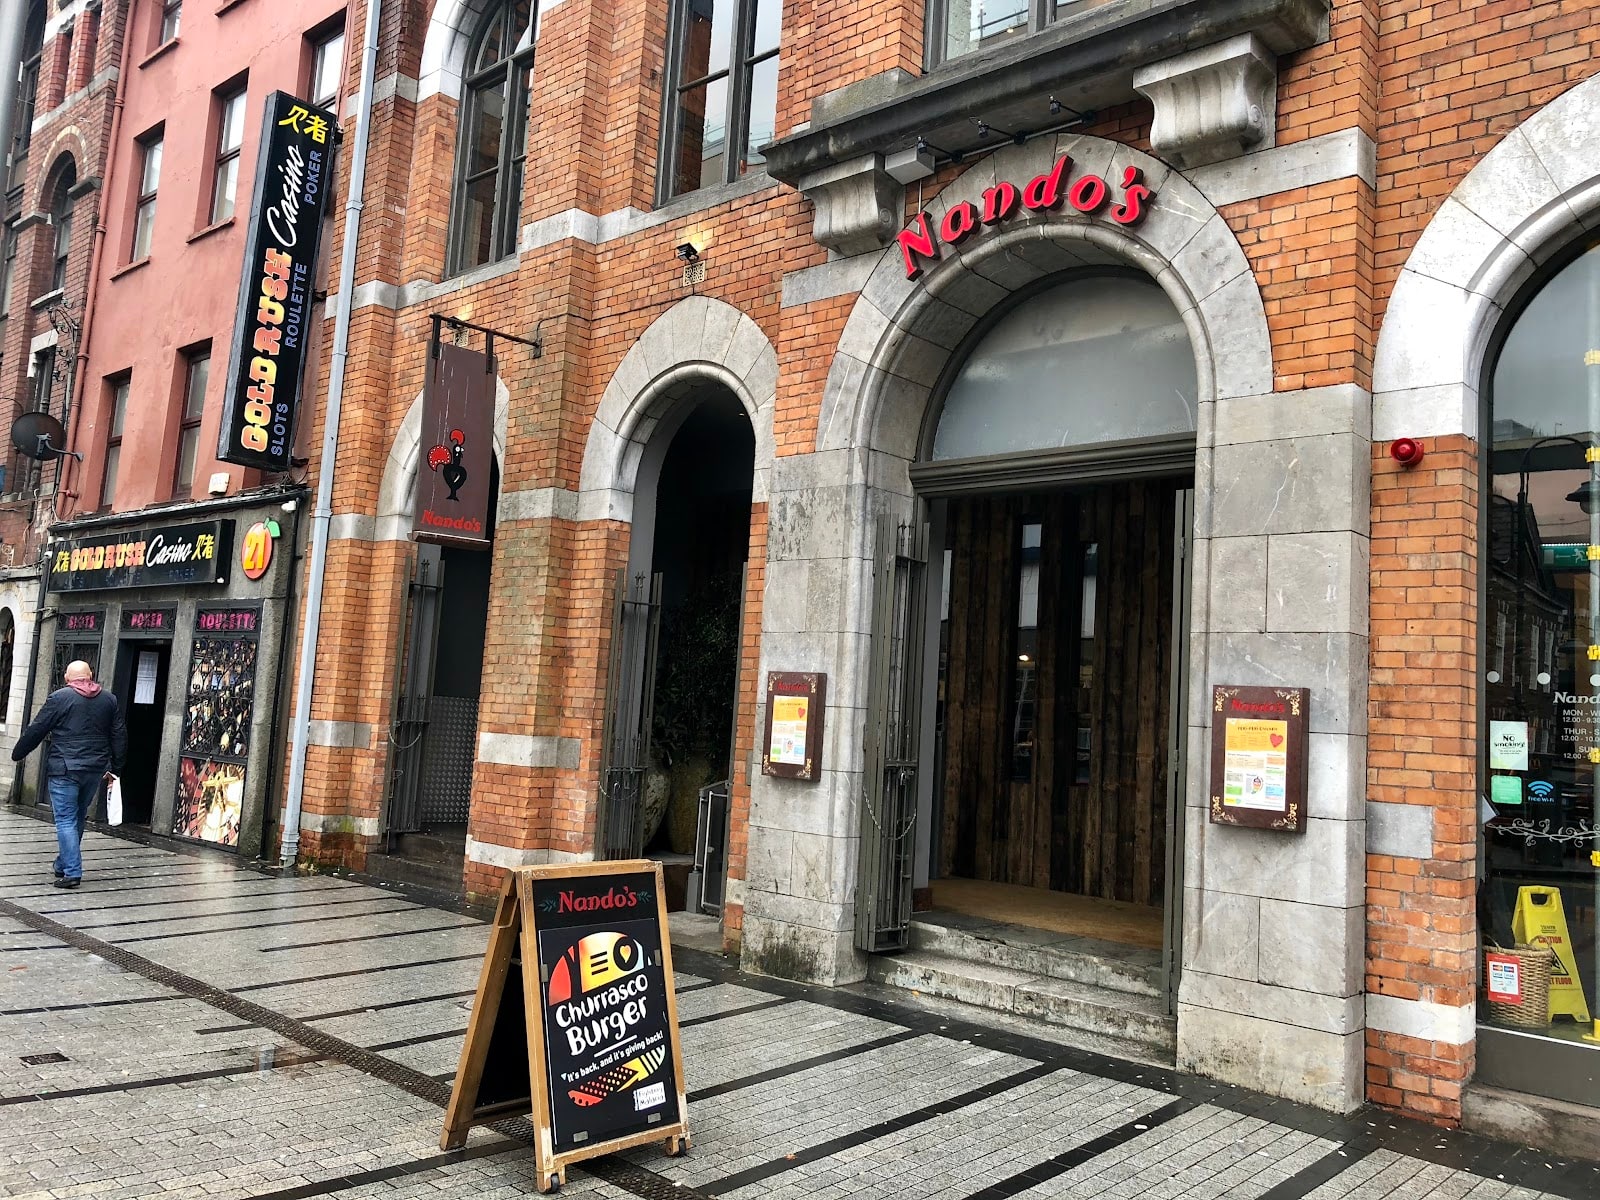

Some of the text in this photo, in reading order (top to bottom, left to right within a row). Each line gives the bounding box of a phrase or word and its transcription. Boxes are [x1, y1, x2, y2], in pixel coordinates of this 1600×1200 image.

[304, 149, 322, 205] POKER
[896, 153, 1156, 282] Nando's
[240, 145, 304, 452] GOLD RUSH Casino
[285, 263, 307, 347] ROULETTE
[271, 403, 289, 456] SLOTS
[420, 510, 481, 532] Nando's
[70, 546, 104, 572] GOLD
[104, 541, 146, 567] RUSH
[146, 534, 193, 568] Casino
[244, 533, 267, 570] 21
[1562, 709, 1584, 717] MON
[557, 885, 638, 914] Nando's
[555, 973, 649, 1028] Churrasco
[565, 996, 647, 1056] Burger
[567, 1030, 664, 1083] It's back, and it's giving back!
